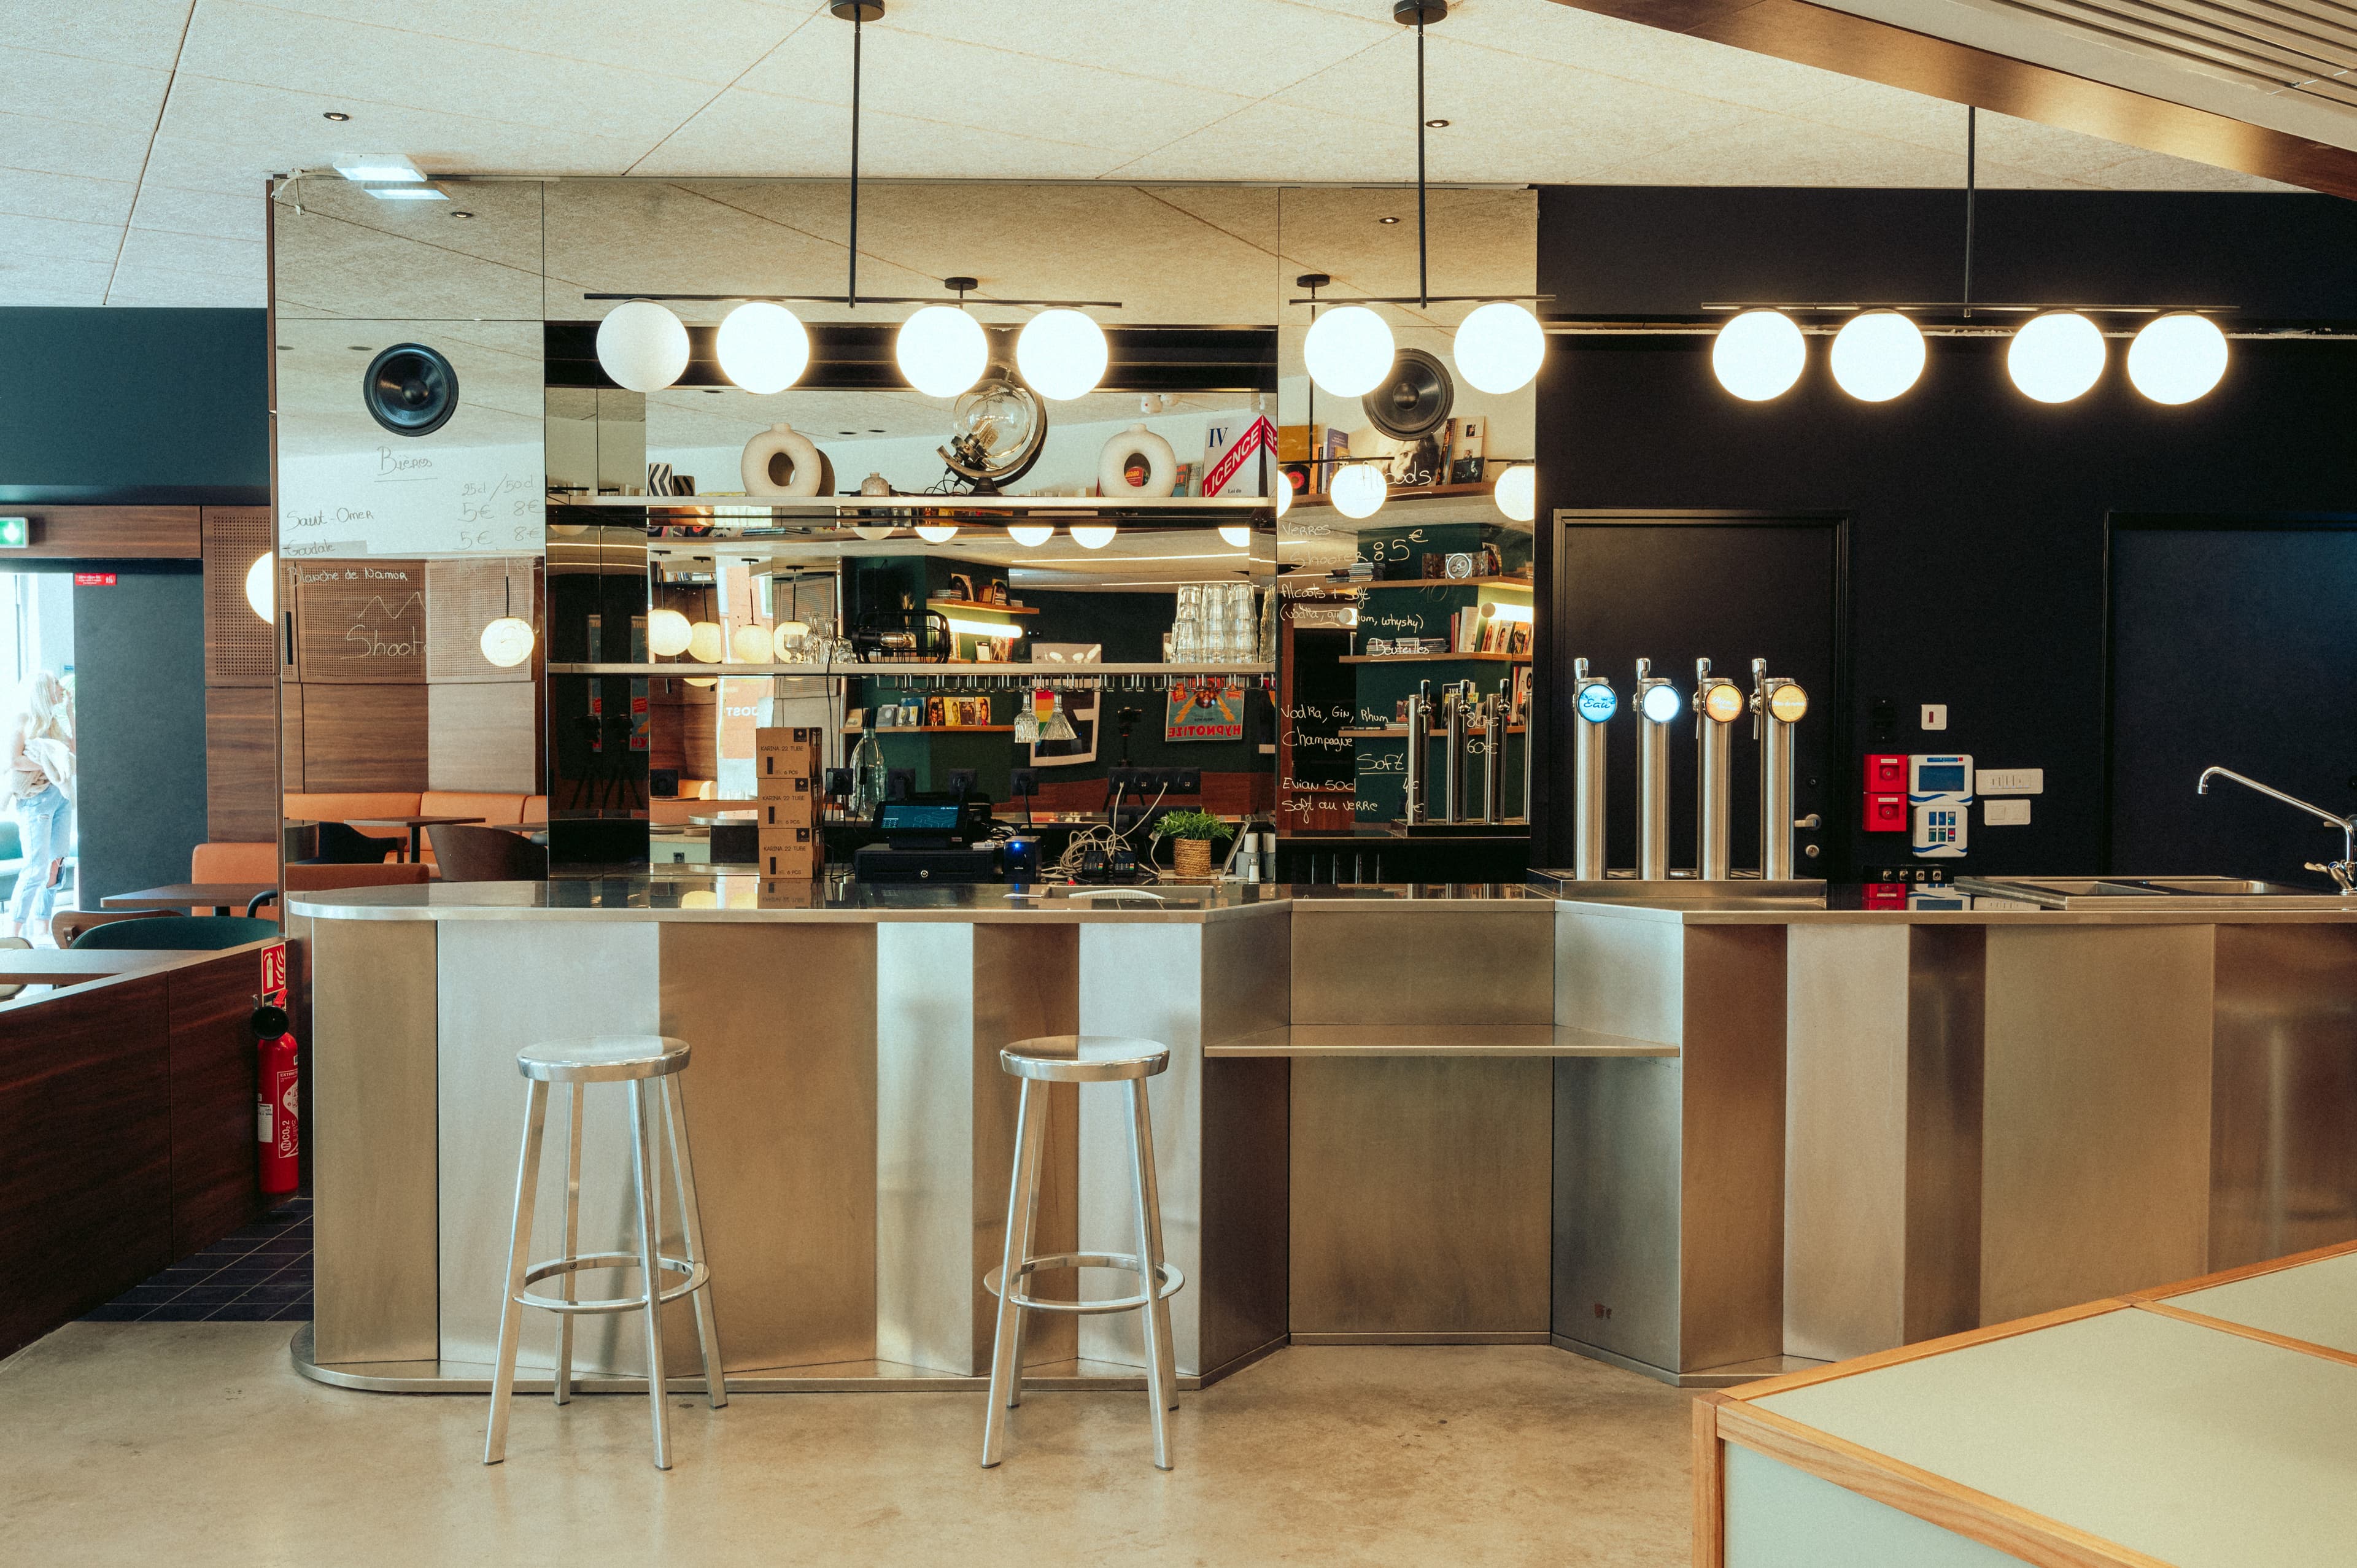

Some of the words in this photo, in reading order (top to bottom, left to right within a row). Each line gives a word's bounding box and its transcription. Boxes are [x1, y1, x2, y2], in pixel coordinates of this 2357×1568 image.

[1208, 427, 1228, 448] IV
[1205, 425, 1260, 496] LICENCE
[457, 503, 495, 522] 5€
[514, 499, 545, 516] 8€
[345, 568, 358, 580] de
[1584, 698, 1611, 709] Eau
